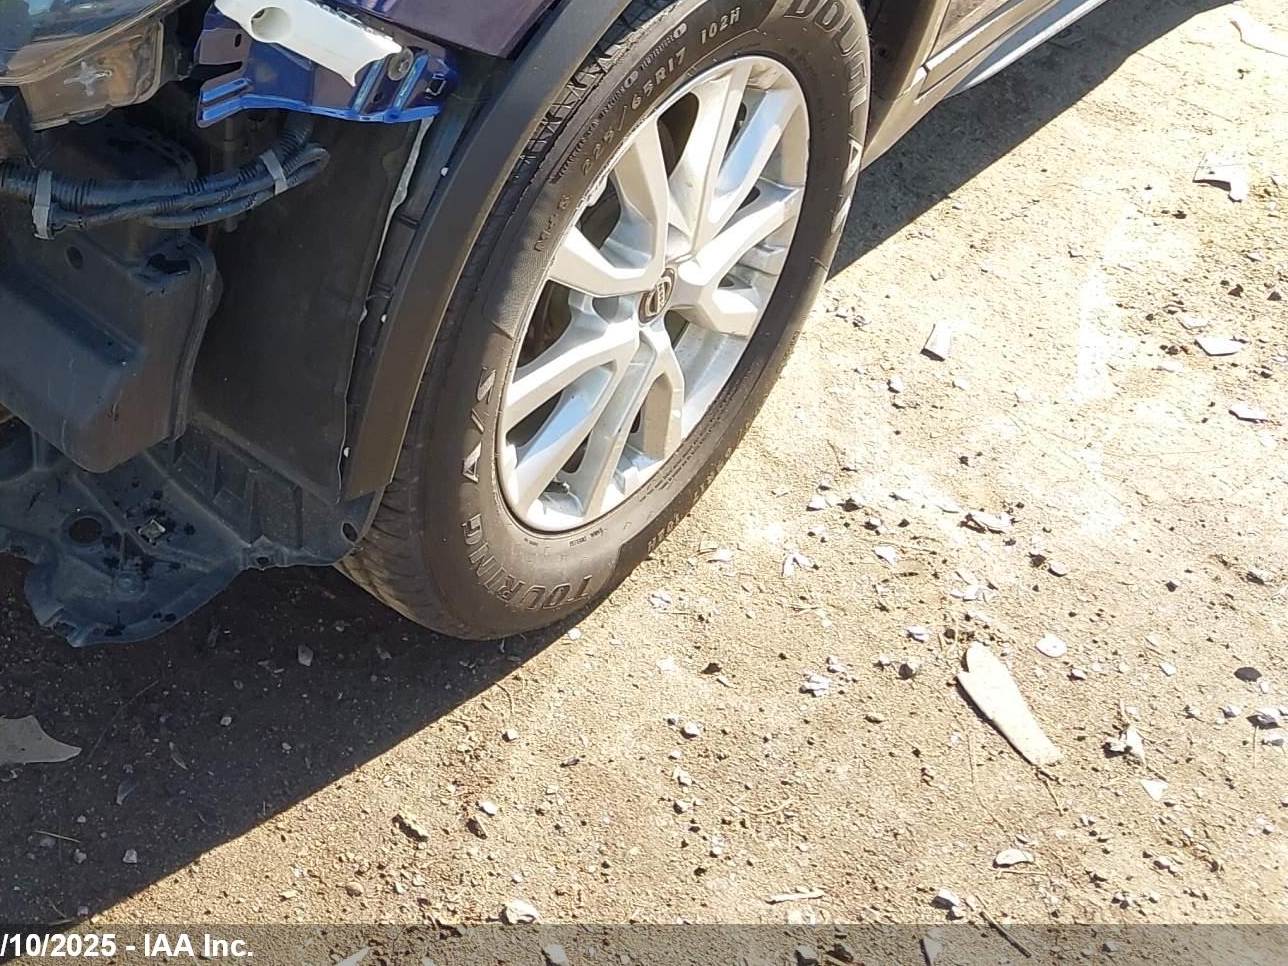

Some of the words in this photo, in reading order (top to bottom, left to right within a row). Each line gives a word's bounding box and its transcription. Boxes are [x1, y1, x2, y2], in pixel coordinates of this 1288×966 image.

[582, 46, 688, 176] 225/65R17
[700, 6, 742, 45] 102H
[462, 366, 497, 484] A/S
[461, 513, 593, 611] TOURING
